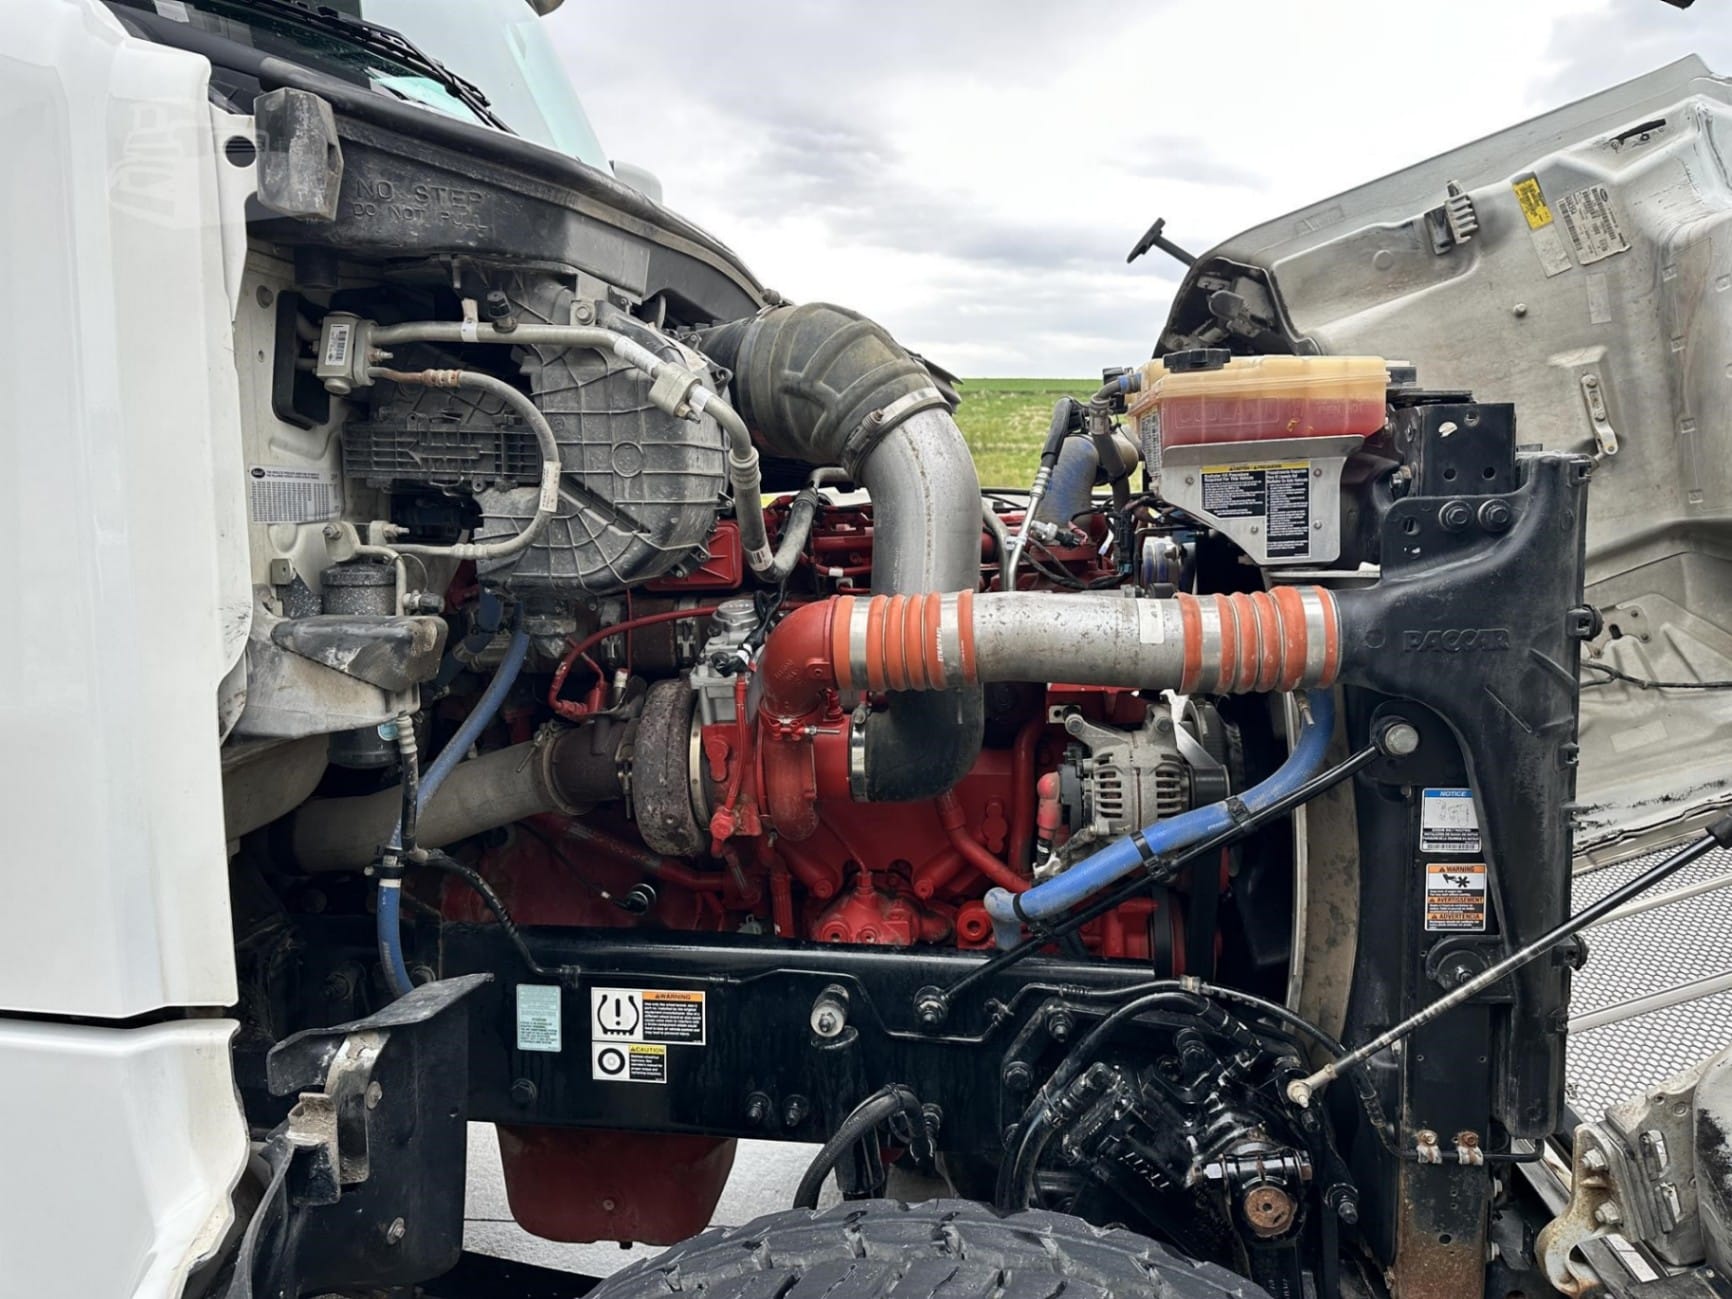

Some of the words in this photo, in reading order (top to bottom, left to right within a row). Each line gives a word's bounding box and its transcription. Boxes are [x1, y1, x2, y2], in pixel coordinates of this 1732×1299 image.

[356, 179, 395, 202] NO
[413, 183, 484, 209] STEP
[353, 202, 377, 217] DO
[388, 204, 425, 221] NOT
[1402, 627, 1512, 653] PACCAR
[1446, 865, 1475, 873] WARNING
[660, 992, 691, 1000] WARNING
